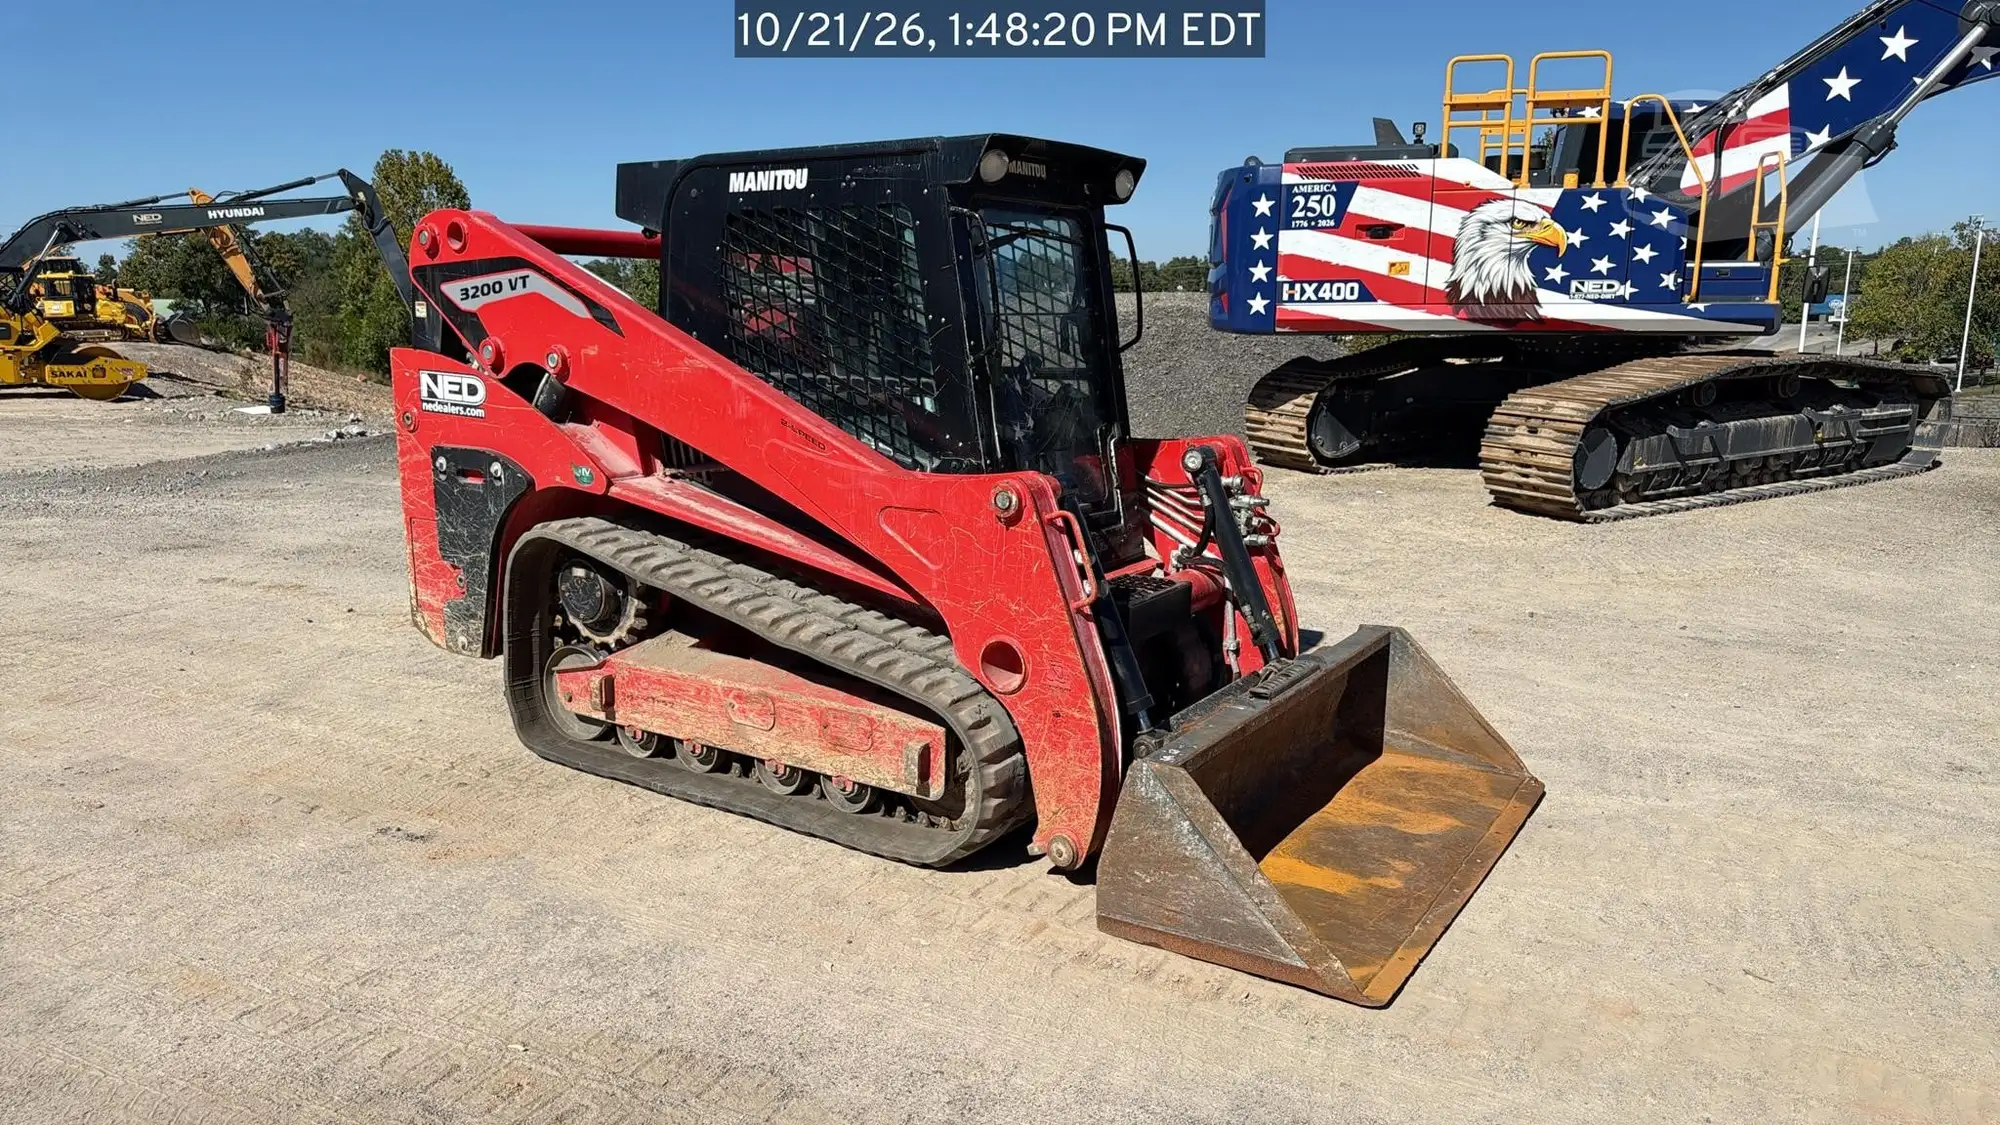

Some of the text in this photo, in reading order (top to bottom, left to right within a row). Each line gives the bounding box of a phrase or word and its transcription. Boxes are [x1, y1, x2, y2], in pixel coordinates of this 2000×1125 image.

[1008, 159, 1047, 180] MANITOU
[729, 168, 808, 193] MANITOU
[1292, 184, 1337, 193] AMERICA
[207, 207, 264, 219] HYUNDAI
[1291, 194, 1336, 218] 250
[132, 213, 162, 222] NED
[1291, 219, 1335, 228] 1776 2026
[460, 275, 530, 301] 3200 VT
[1282, 282, 1360, 301] HX400
[1570, 280, 1620, 293] NED
[51, 370, 87, 378] SAKAI
[421, 373, 485, 404] NED
[422, 402, 485, 417] nedealers.com
[780, 418, 826, 451] 2-SPEED
